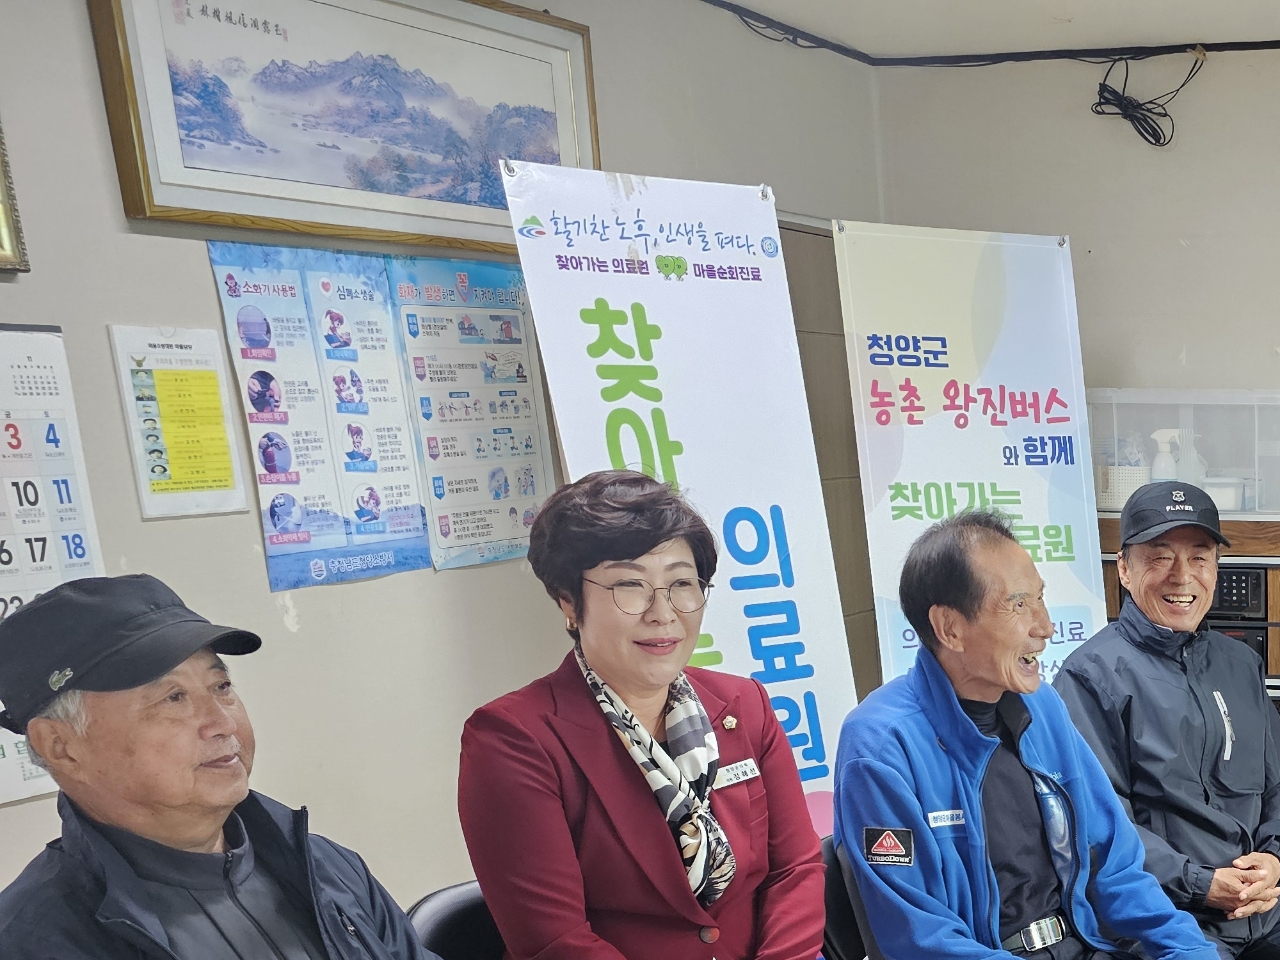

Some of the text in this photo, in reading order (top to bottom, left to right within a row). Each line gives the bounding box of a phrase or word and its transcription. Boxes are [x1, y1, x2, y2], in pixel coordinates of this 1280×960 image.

[549, 209, 611, 248] 활기찬
[658, 221, 712, 252] 인생을
[555, 254, 763, 282] 찾아가는 의료원 마을순회진료
[242, 280, 297, 298] 소화기 사용법
[398, 284, 422, 300] 화재가
[424, 284, 456, 302] 발생하면
[473, 288, 495, 301] 지켜야
[866, 333, 950, 368] 청양군
[868, 377, 1072, 430] 농촌 왕진버스
[4, 423, 61, 450] 3 4
[1022, 435, 1076, 467] 함께
[11, 478, 73, 507] 10 11
[1165, 504, 1194, 512] PLAYER
[0, 533, 86, 566] 6 17 18
[1014, 524, 1077, 565] 료원
